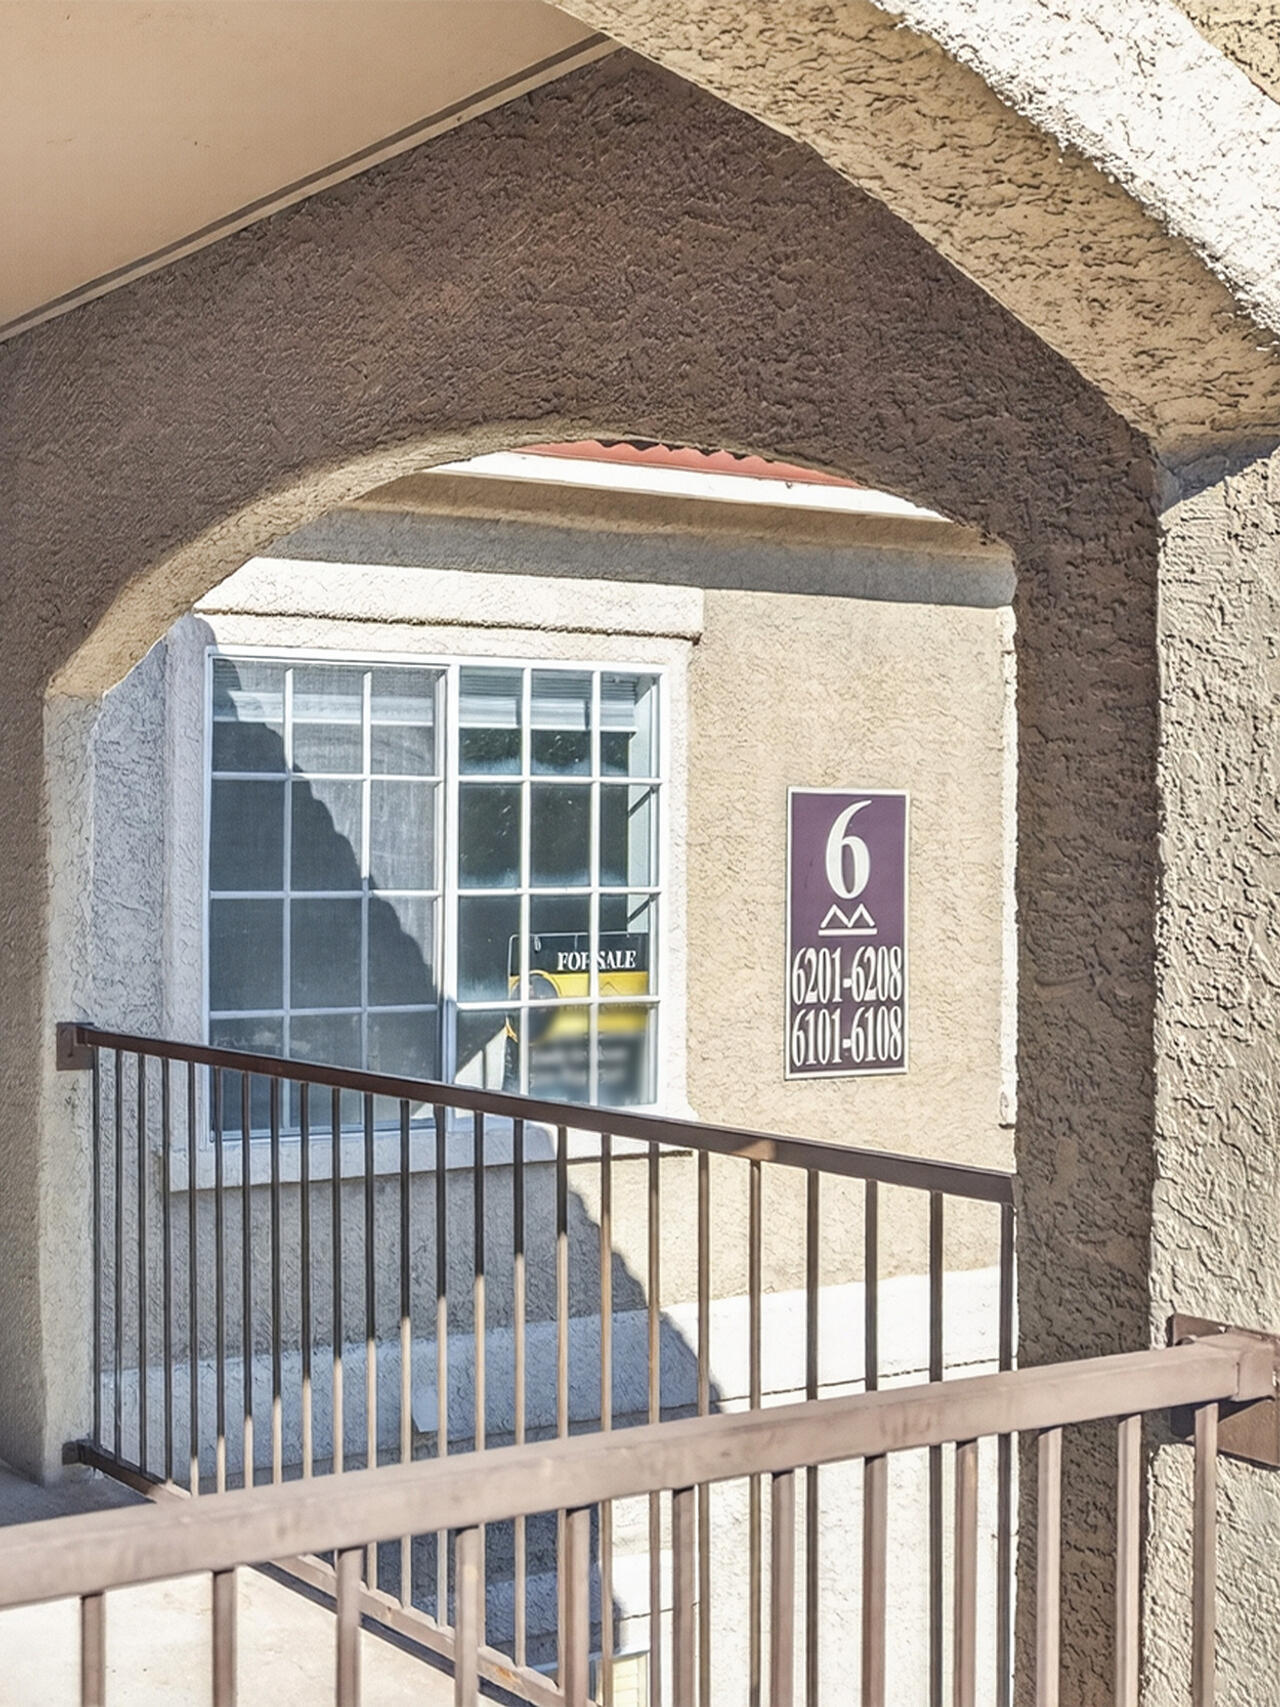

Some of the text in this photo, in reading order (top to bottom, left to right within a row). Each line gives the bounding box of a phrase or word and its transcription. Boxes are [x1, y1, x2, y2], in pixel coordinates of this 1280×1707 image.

[825, 800, 872, 899] 6
[595, 949, 636, 969] SALE
[792, 946, 902, 1005] 6201-6208
[791, 1006, 902, 1066] 6101-6108
